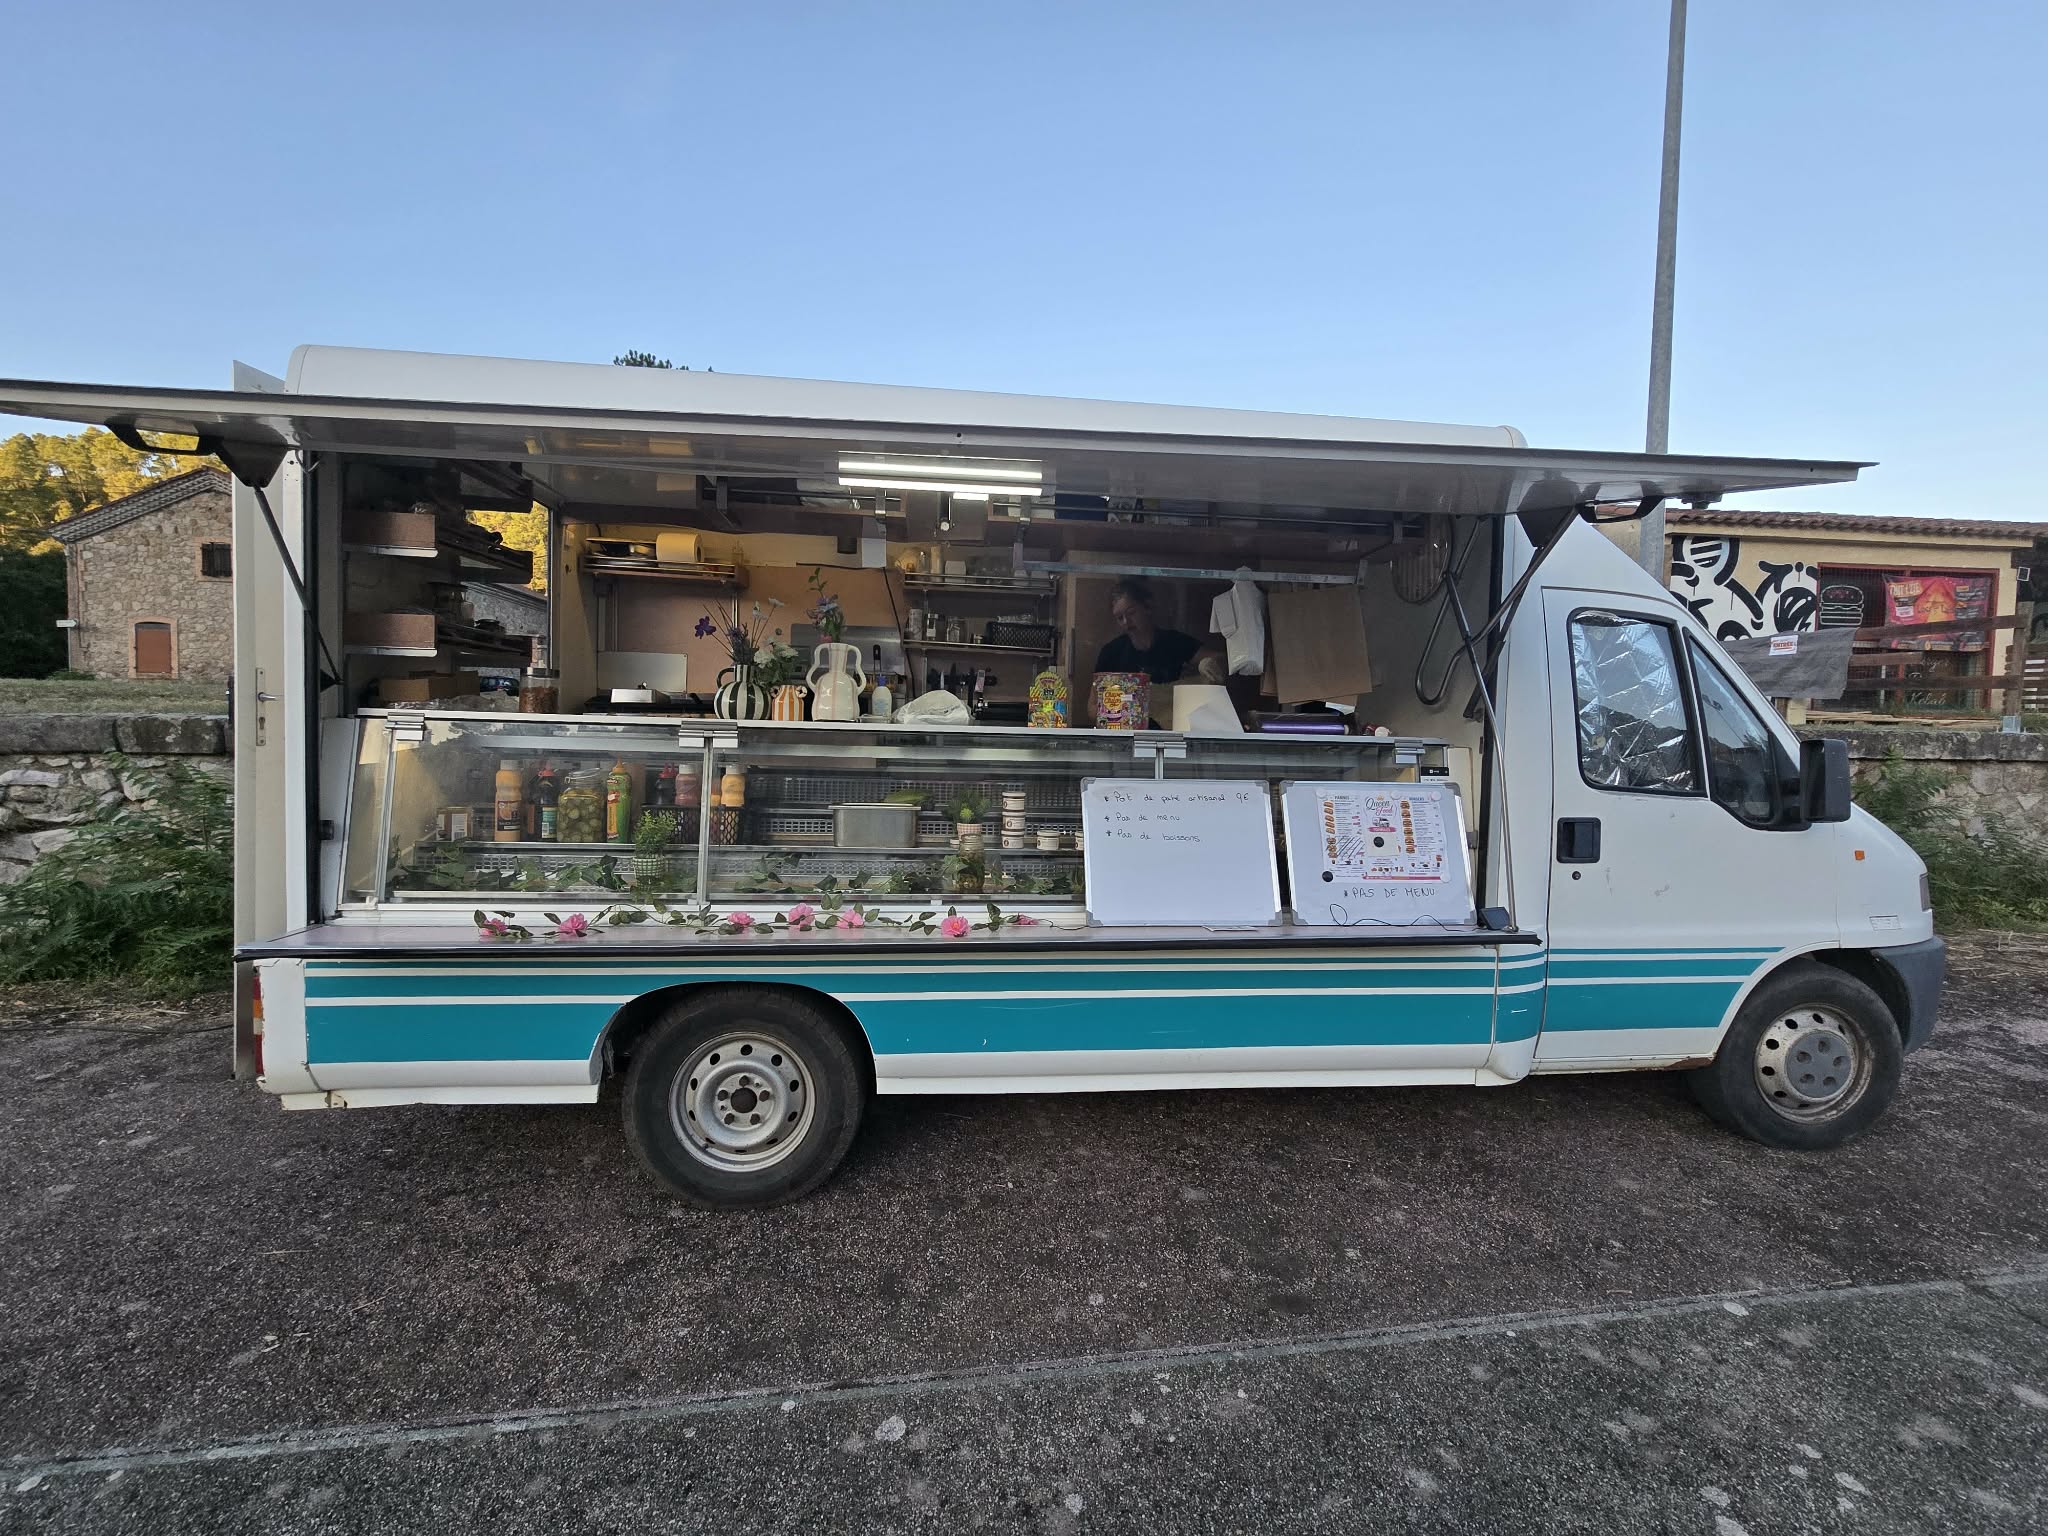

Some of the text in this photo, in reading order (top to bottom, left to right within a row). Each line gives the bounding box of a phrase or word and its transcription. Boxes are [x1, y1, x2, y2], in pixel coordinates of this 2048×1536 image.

[1114, 791, 1132, 802] Pot
[1365, 797, 1391, 811] Queen
[1352, 886, 1435, 898] PAS DE MENU
